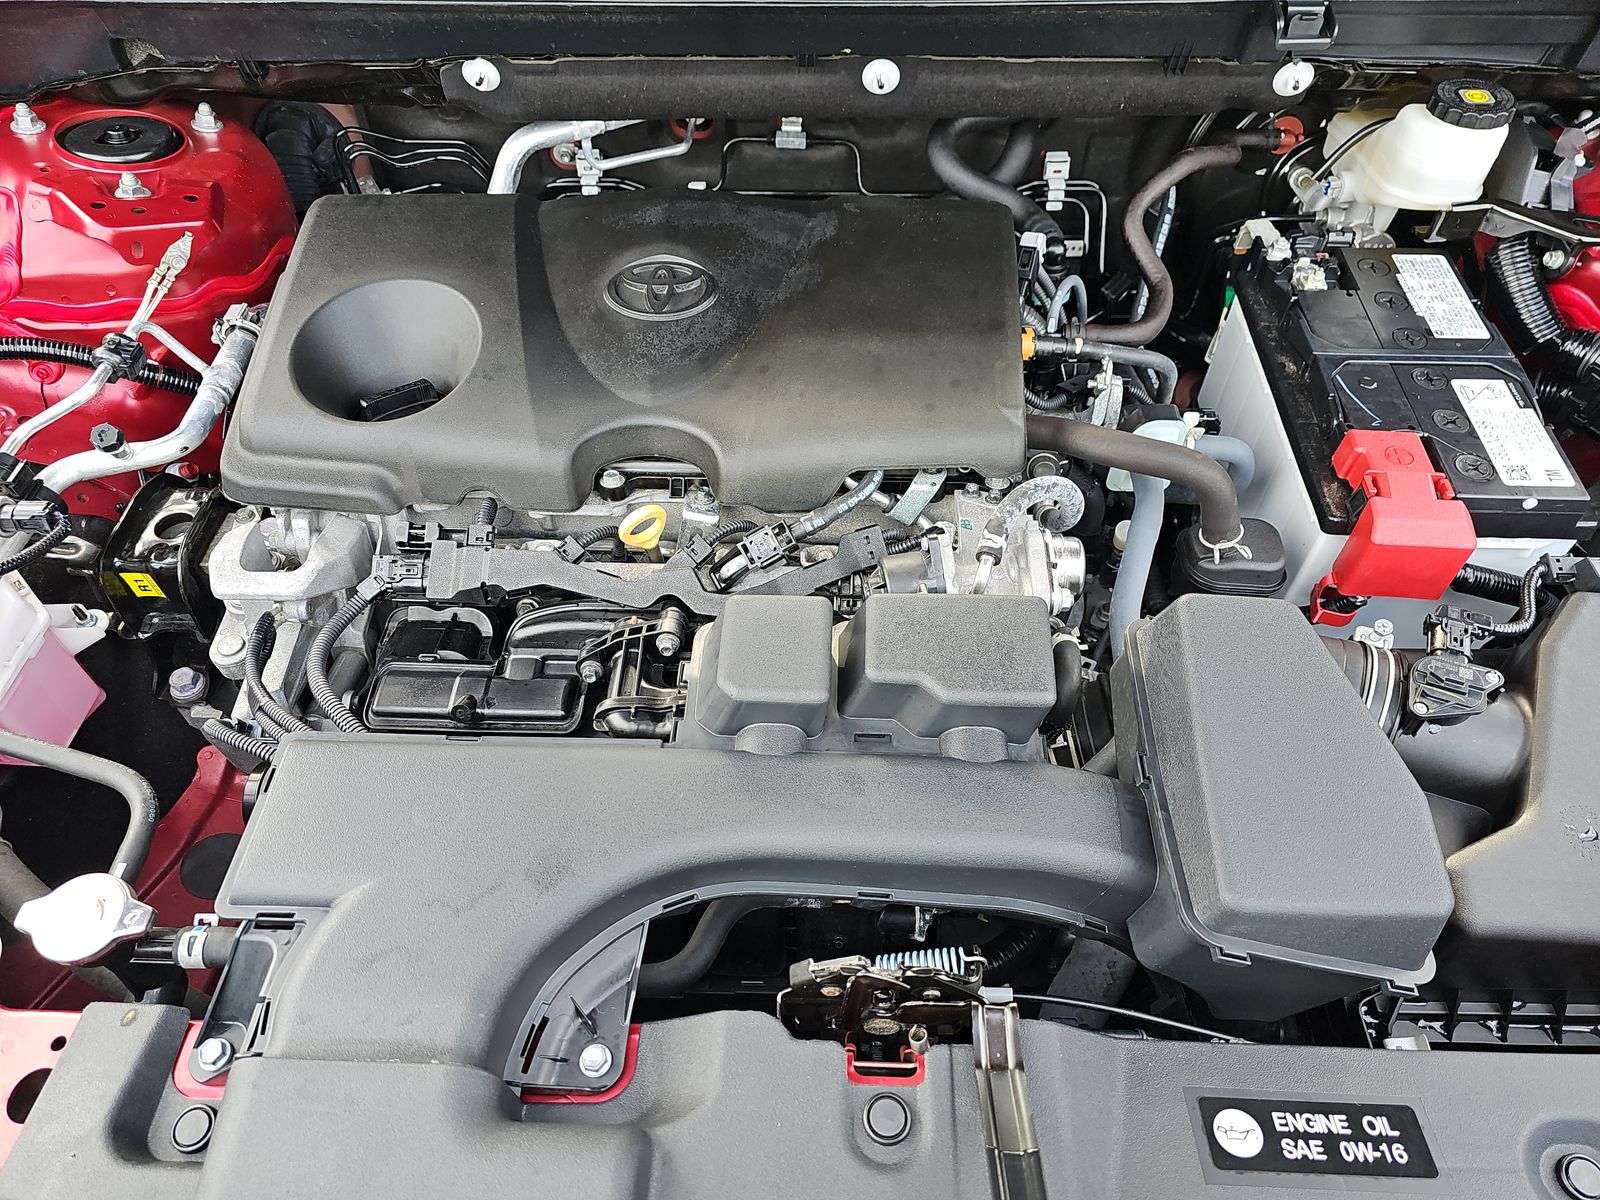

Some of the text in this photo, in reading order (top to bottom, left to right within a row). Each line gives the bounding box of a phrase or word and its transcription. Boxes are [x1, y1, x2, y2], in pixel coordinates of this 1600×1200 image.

[132, 579, 153, 592] R1
[1271, 1111, 1401, 1137] ENGINE OIL
[1280, 1137, 1409, 1165] SAE 0W-16
